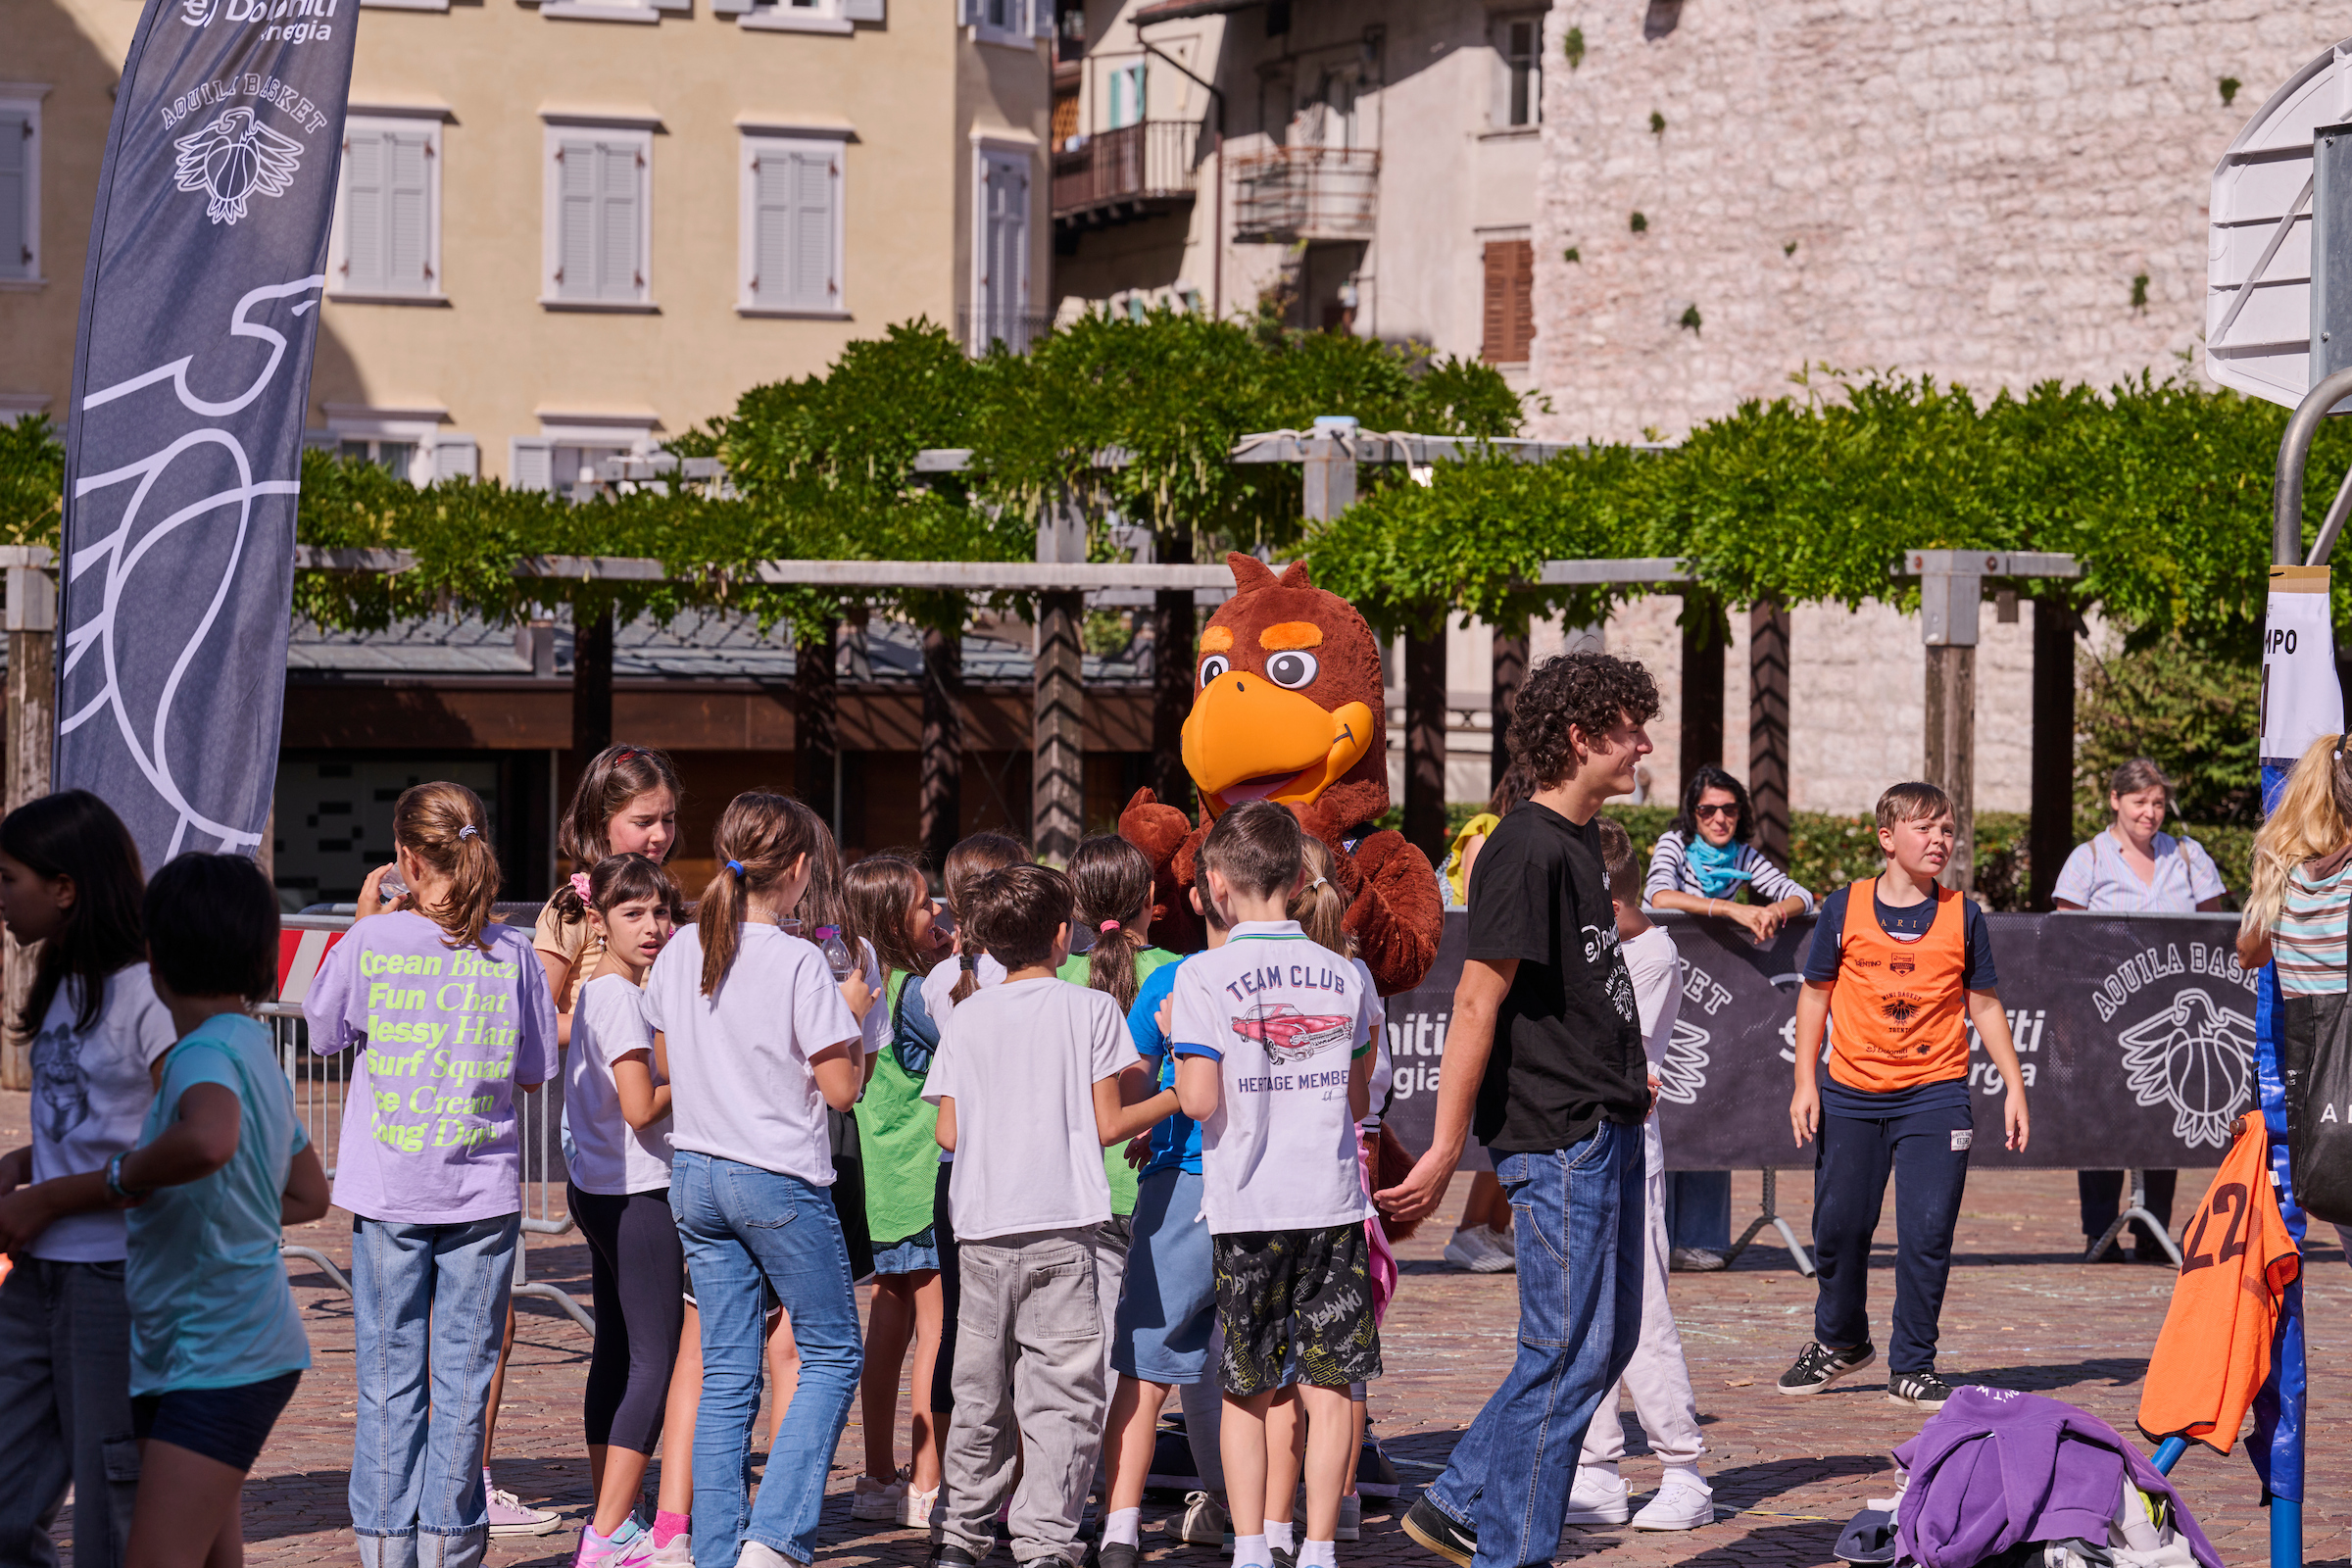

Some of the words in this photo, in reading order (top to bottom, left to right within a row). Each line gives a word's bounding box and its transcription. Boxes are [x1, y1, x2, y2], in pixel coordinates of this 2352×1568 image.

[243, 73, 327, 134] BASKET
[360, 950, 443, 977] Ocean
[368, 983, 427, 1010] Fun
[436, 982, 511, 1013] Chat
[1226, 965, 1283, 1002] TEAM
[1290, 965, 1345, 996] CLUB
[1882, 992, 1896, 1002] MINI
[1897, 991, 1923, 1002] BASKET
[2092, 943, 2185, 1022] AQUILA
[452, 1016, 520, 1047] Hair
[367, 1049, 426, 1077] Surf
[429, 1050, 514, 1088] Squad
[409, 1085, 495, 1115] Cream
[431, 1118, 498, 1154] Days
